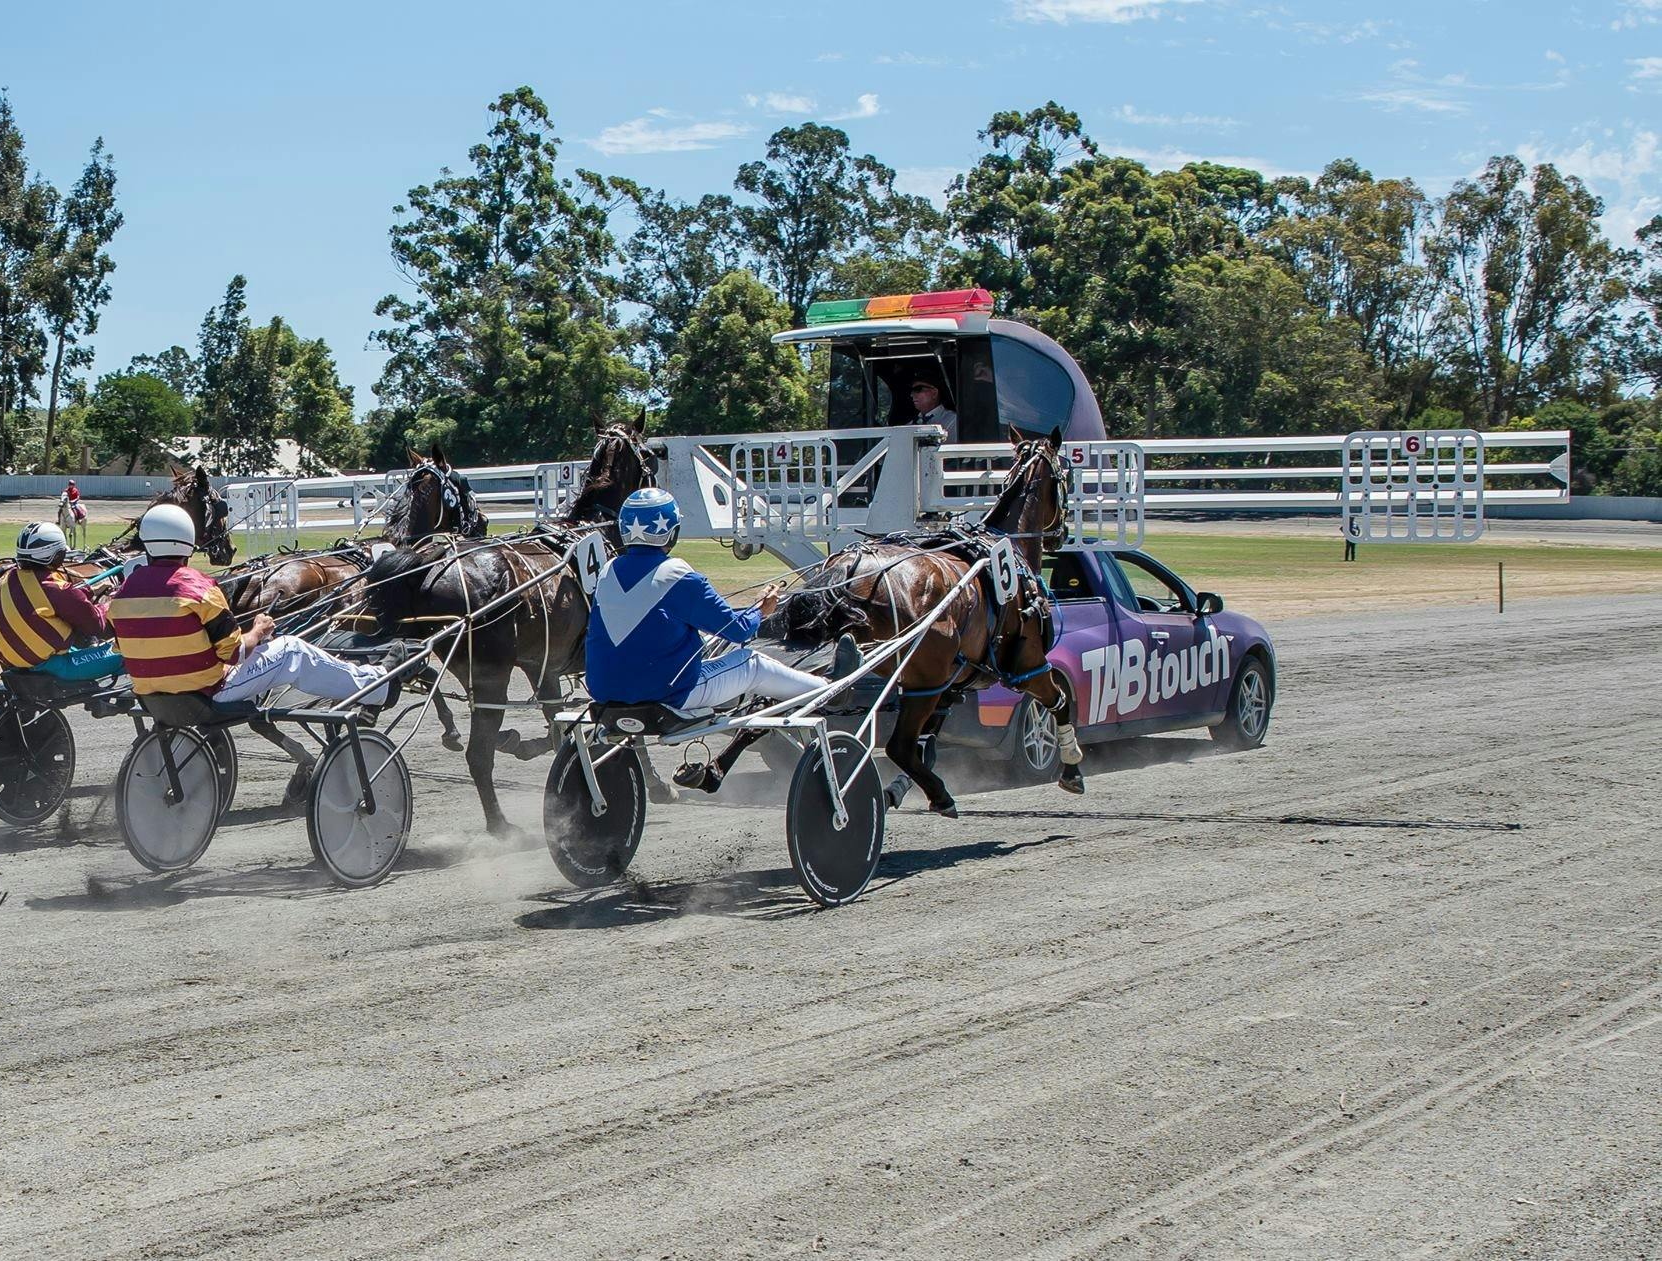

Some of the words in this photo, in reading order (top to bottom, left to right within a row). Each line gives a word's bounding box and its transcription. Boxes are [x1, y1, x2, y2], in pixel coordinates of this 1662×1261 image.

[776, 444, 788, 460] 4
[1405, 436, 1420, 452] 6
[1071, 447, 1085, 464] 5
[561, 465, 571, 480] 3
[444, 488, 457, 508] 3
[586, 542, 601, 583] 4
[997, 548, 1012, 591] 5
[1081, 624, 1230, 726] TABtouch
